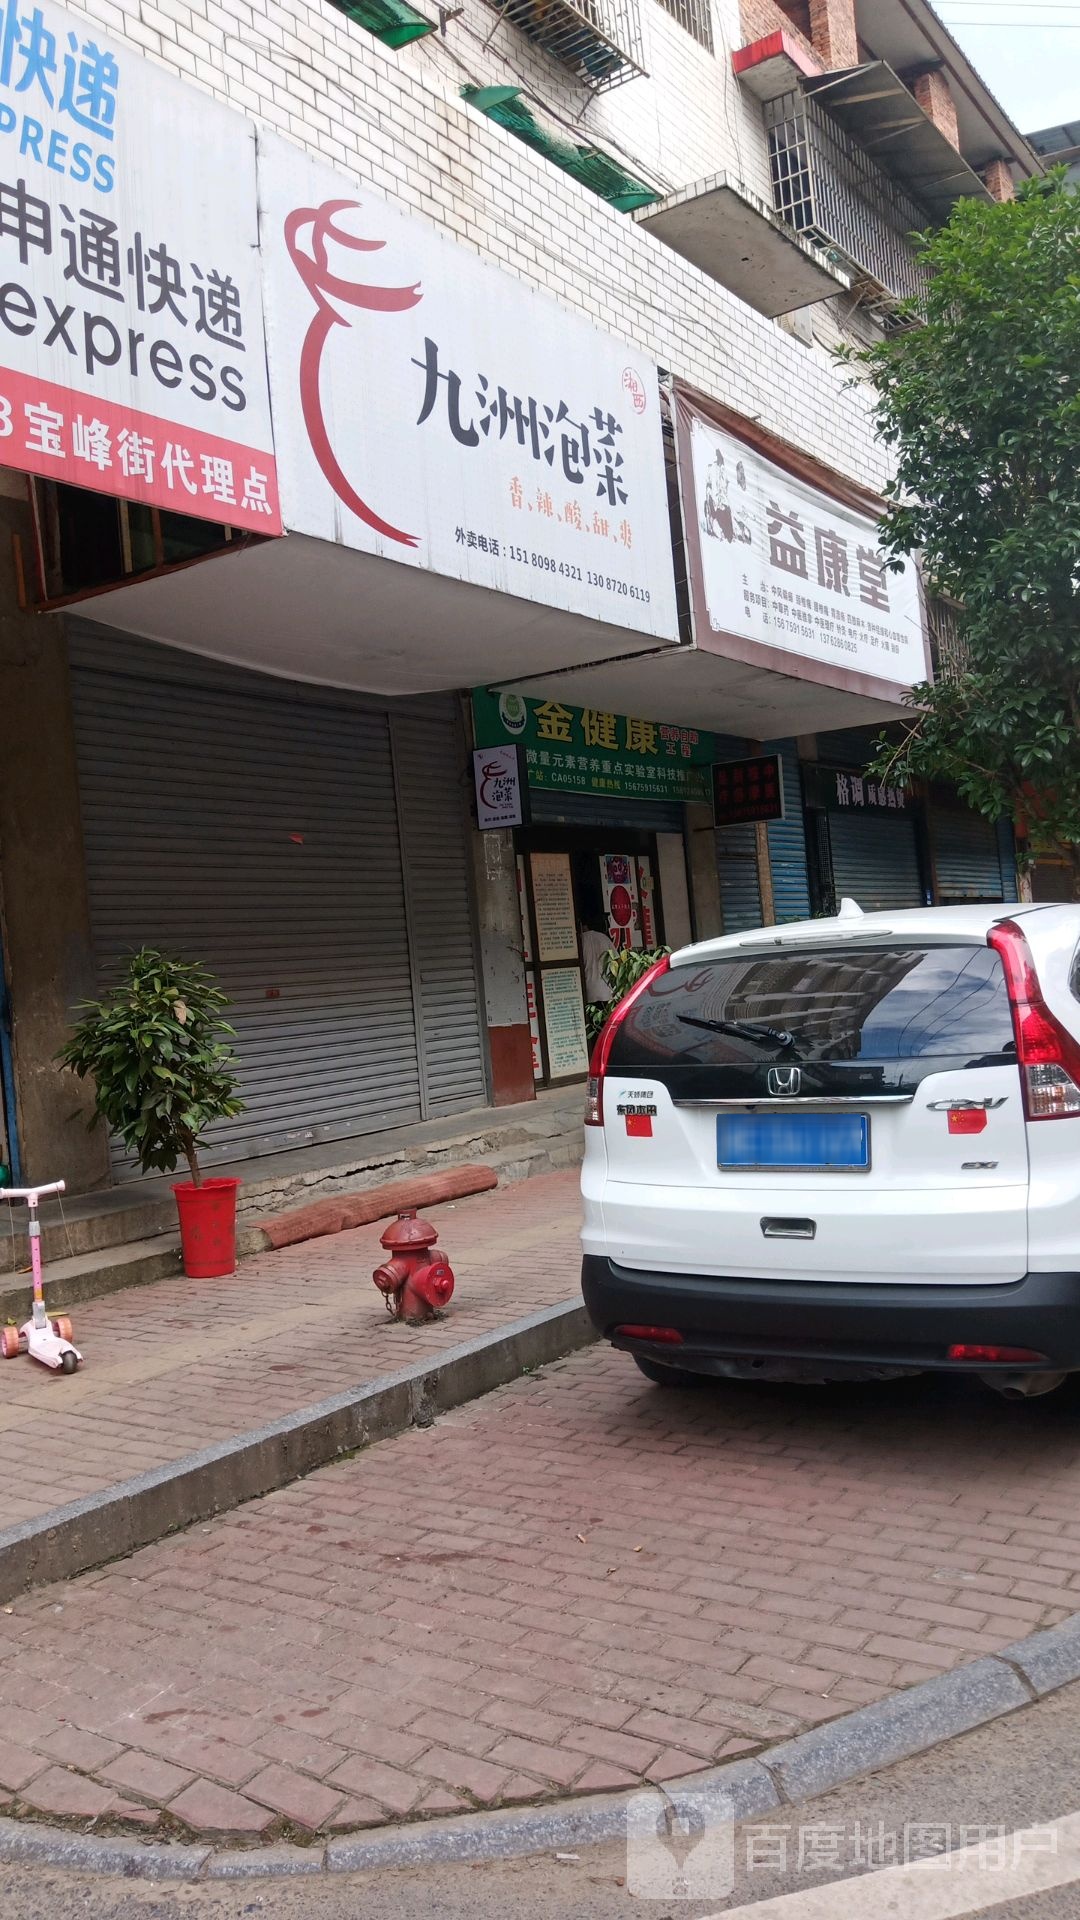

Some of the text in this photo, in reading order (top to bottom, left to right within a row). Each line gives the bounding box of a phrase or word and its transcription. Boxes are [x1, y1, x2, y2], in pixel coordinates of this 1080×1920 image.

[0, 0, 119, 142] 快递
[0, 179, 245, 353] 申通快递
[0, 281, 247, 412] express
[25, 402, 273, 515] 宝峰街代理点
[410, 336, 629, 506] 九洲泡菜
[510, 545, 529, 565] 151
[531, 552, 556, 573] 8098
[558, 561, 583, 582] 4321
[587, 571, 604, 588] 130
[605, 577, 628, 596] 8720
[629, 585, 651, 603] 6119
[766, 499, 891, 614] 益康堂
[532, 700, 659, 755] 金健康
